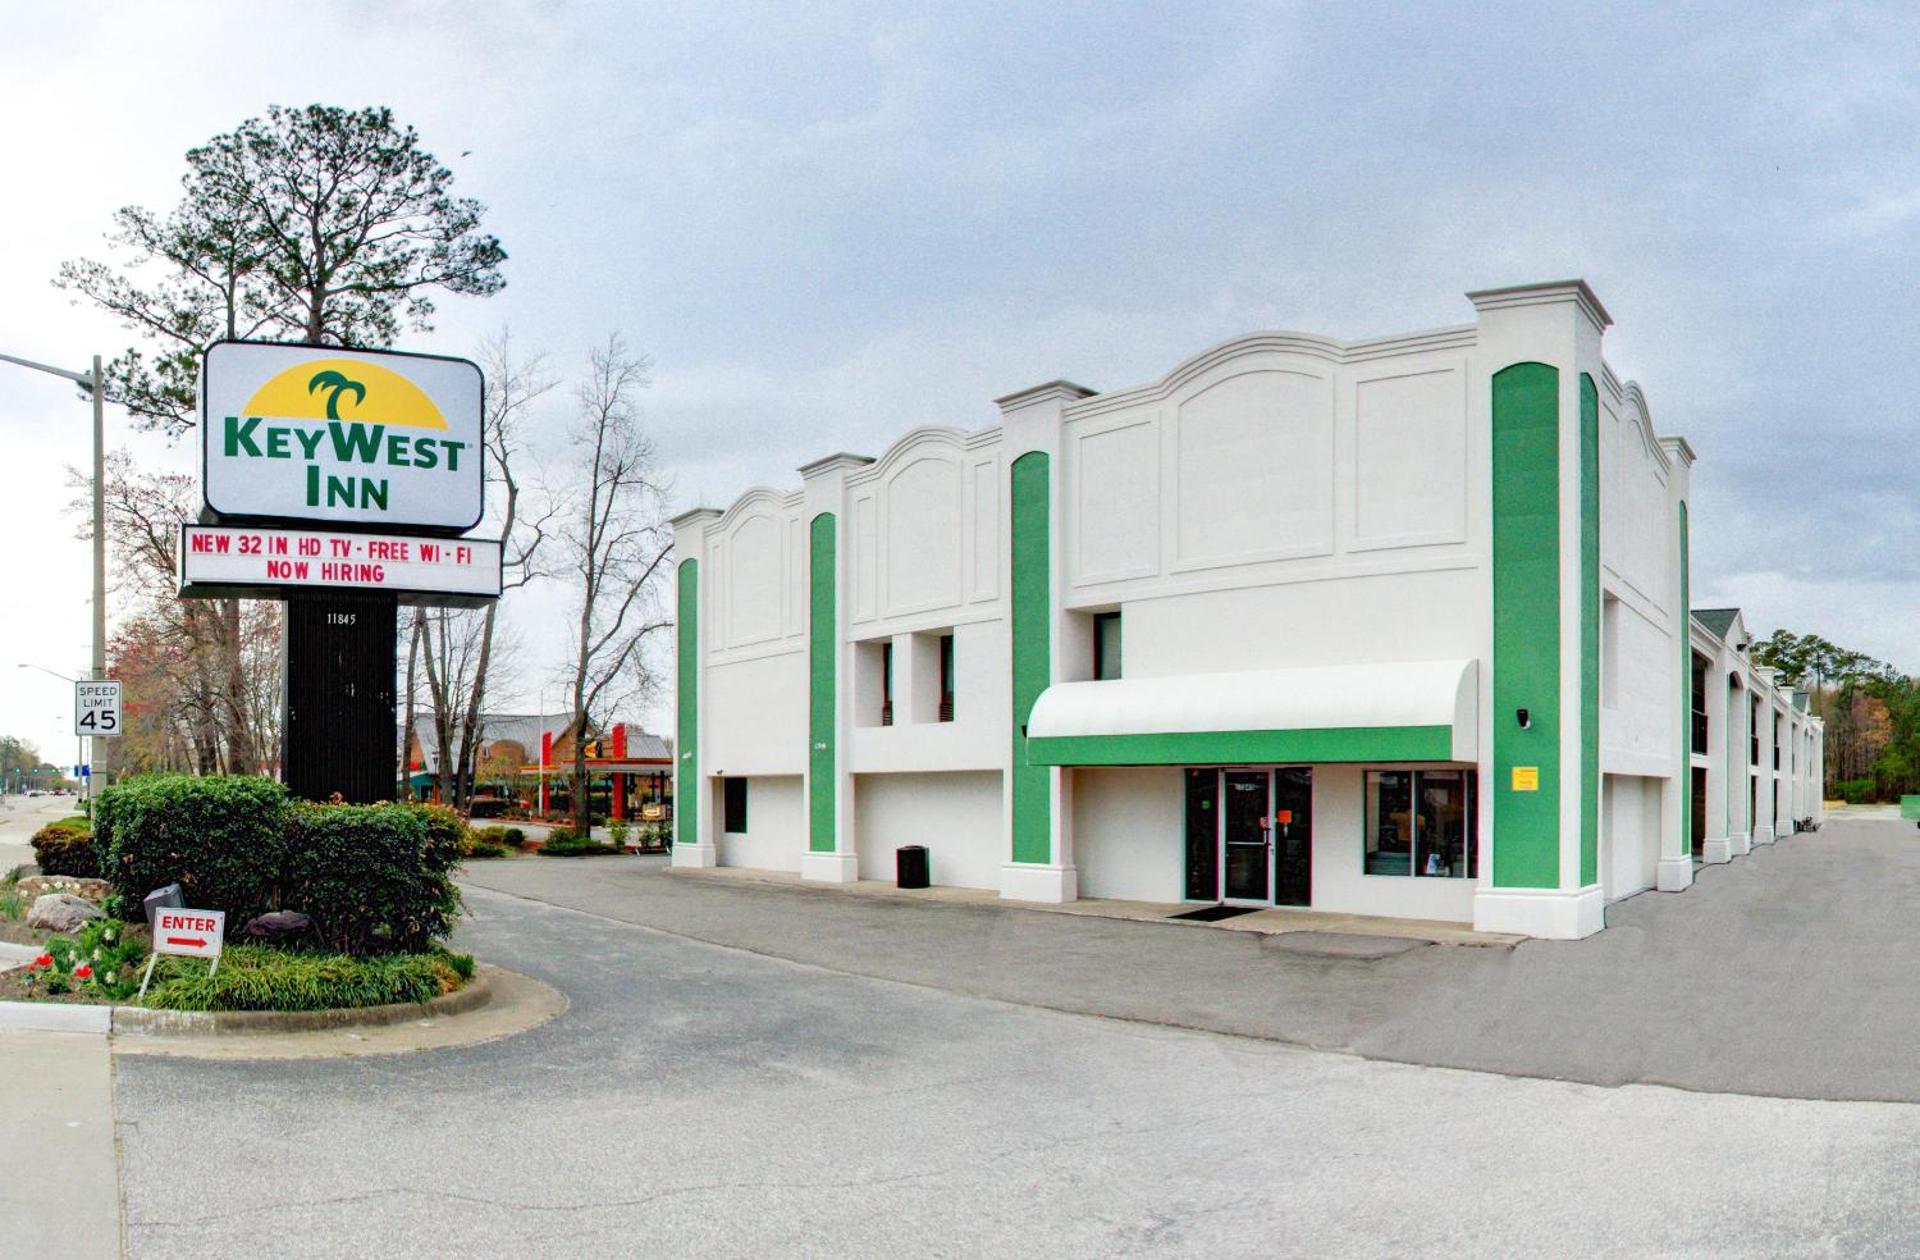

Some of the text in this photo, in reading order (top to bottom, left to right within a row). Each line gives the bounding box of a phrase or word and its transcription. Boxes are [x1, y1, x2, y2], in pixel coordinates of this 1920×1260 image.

[192, 534, 230, 554] NEW
[238, 536, 262, 554] 32
[268, 537, 288, 555] IN
[299, 538, 321, 556] HD
[368, 541, 409, 560] FREE
[267, 560, 384, 583] NOW HIRING
[327, 612, 356, 626] 11845
[80, 687, 117, 696] SPEED
[84, 699, 113, 708] LIMIT
[80, 710, 116, 730] 45
[162, 916, 216, 932] ENTER
